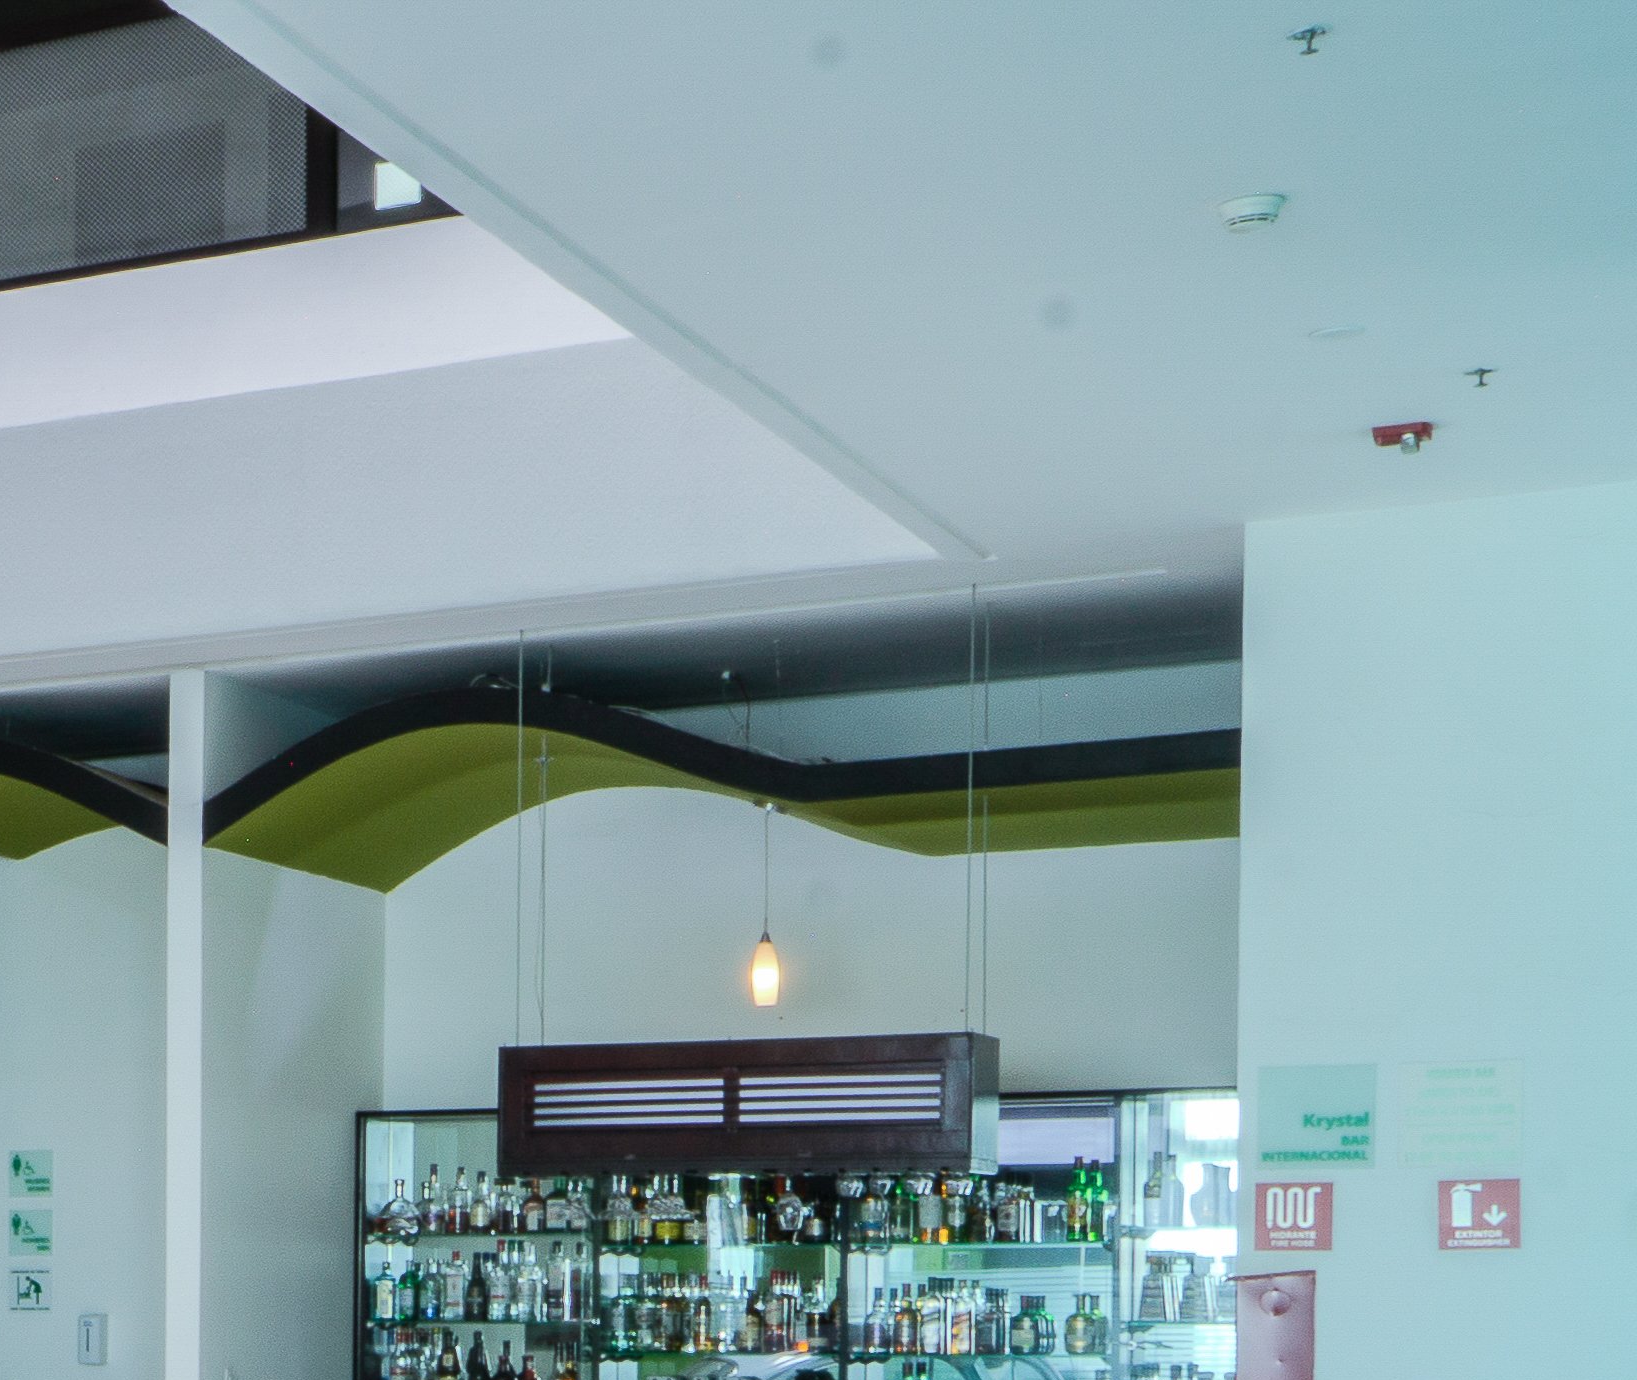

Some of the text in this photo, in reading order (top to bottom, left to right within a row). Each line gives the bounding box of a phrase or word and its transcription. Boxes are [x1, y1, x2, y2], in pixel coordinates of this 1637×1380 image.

[1303, 1111, 1369, 1130] Krystal
[1341, 1135, 1369, 1146] BAR
[1261, 1150, 1368, 1162] INTERNACIONAL
